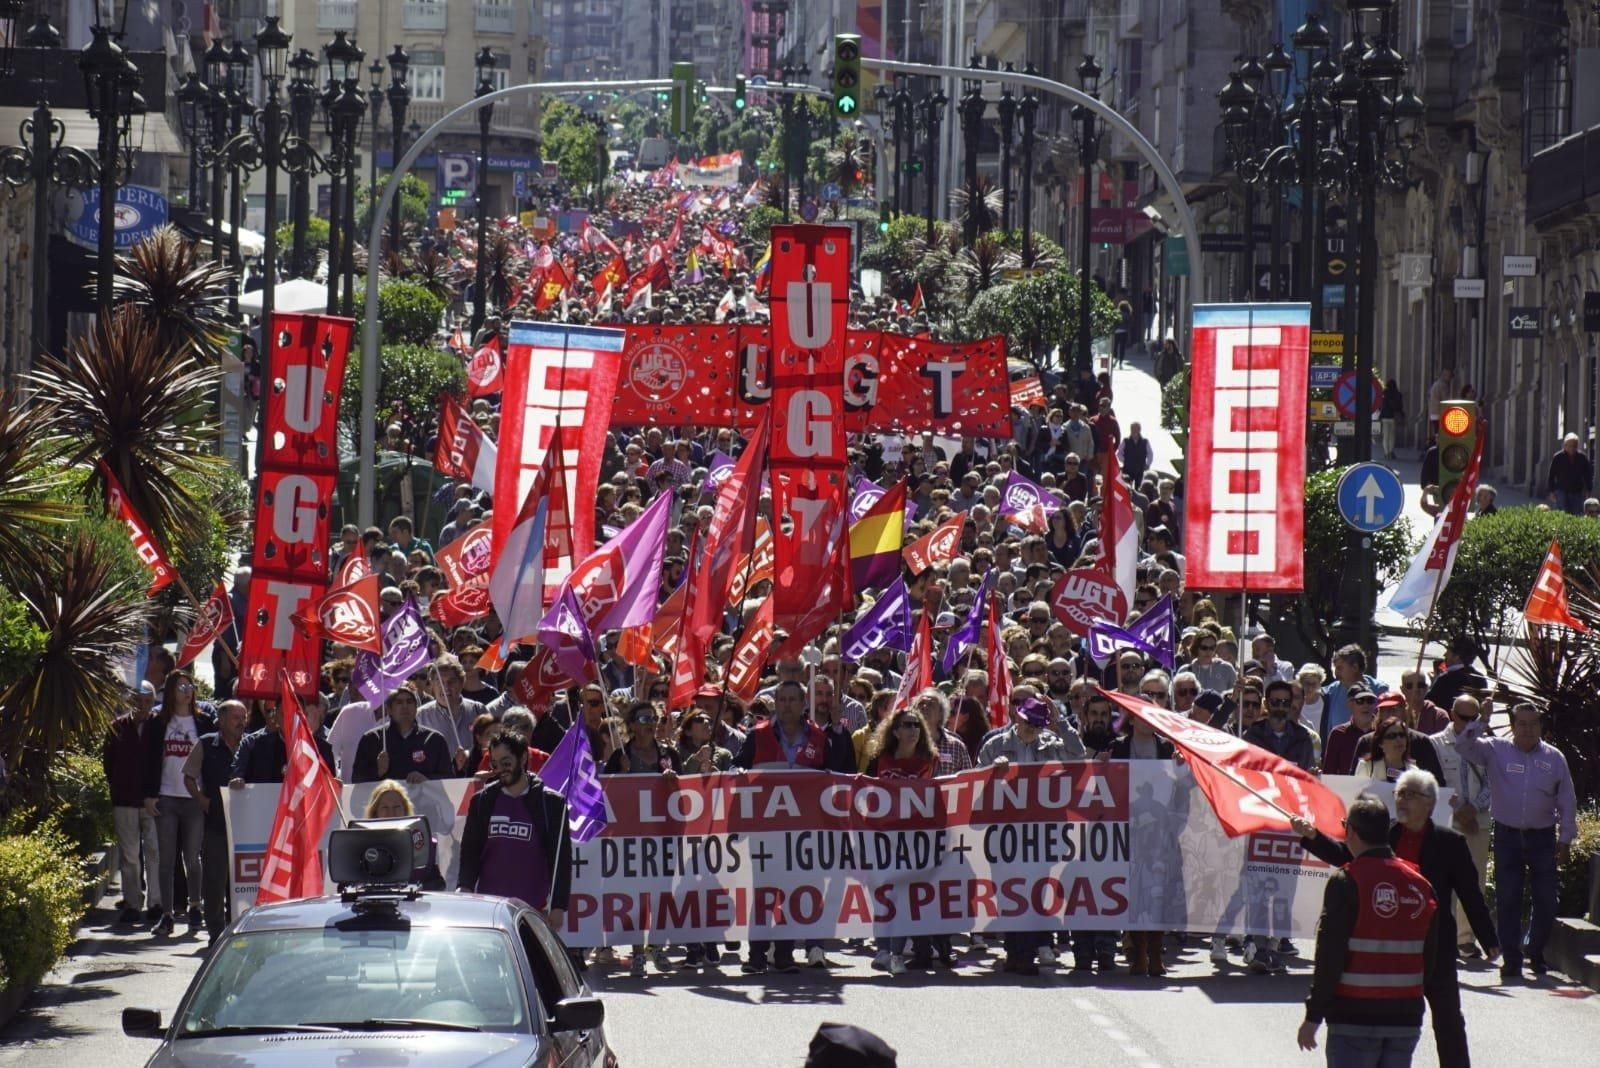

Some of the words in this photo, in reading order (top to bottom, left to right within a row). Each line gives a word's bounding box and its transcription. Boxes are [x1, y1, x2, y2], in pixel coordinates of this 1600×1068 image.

[642, 354, 673, 368] UGT
[646, 402, 672, 411] VIGO
[1209, 327, 1281, 572] CCOO
[265, 364, 327, 650] UGT
[1064, 575, 1118, 614] UGT
[639, 785, 801, 823] LOITA
[819, 769, 1116, 820] CONTINÚA
[489, 823, 529, 837] CCOO
[601, 832, 741, 879] DEREITOS
[785, 830, 947, 871] IGUALDADE
[1247, 864, 1290, 876] comisións
[1292, 869, 1330, 879] obreiras
[567, 884, 824, 933] PRIMEIRO
[837, 883, 897, 924] AS
[908, 876, 1129, 921] PERSOAS
[1376, 887, 1396, 901] UGT
